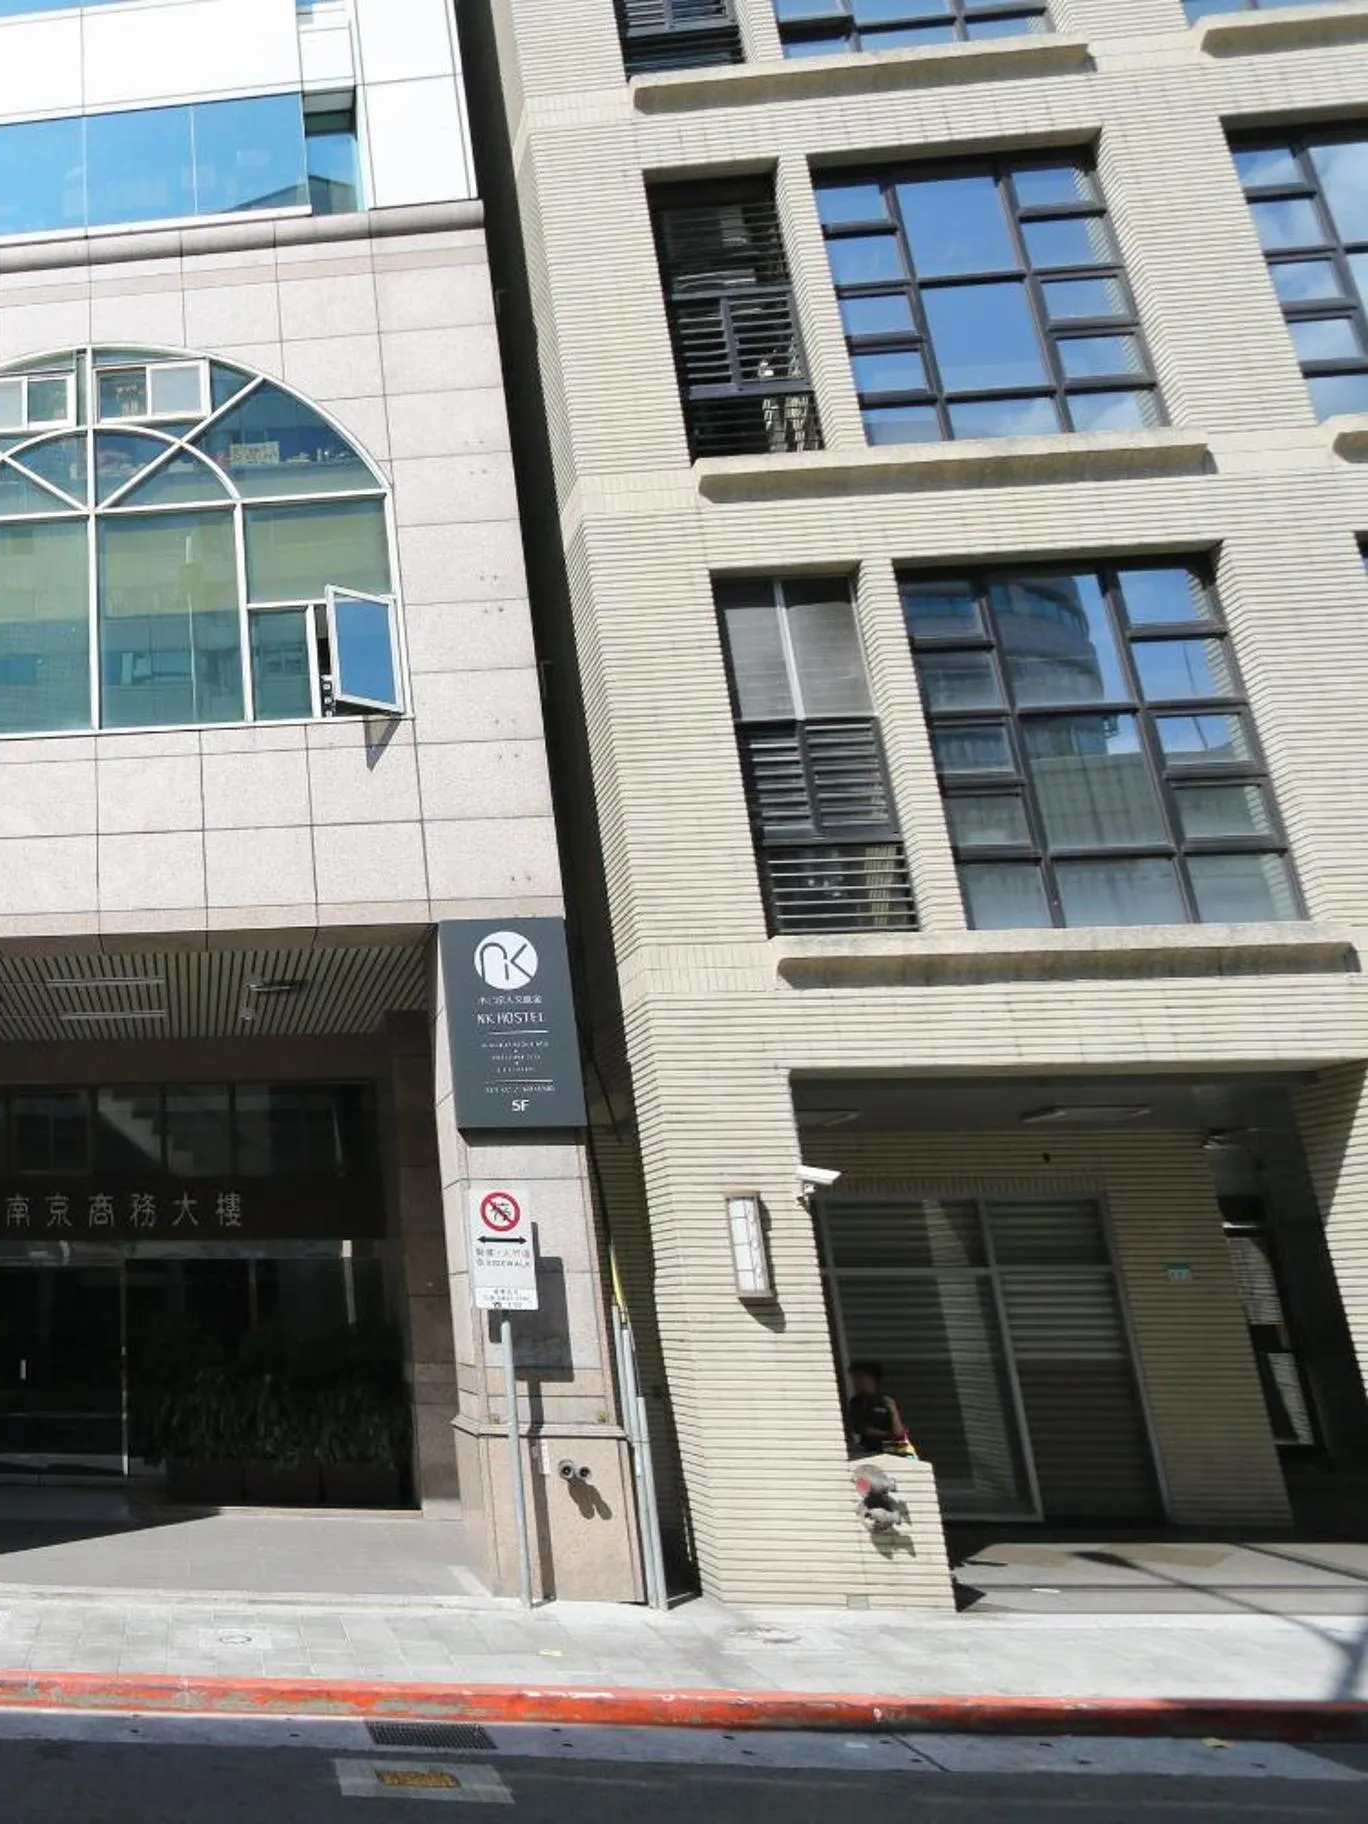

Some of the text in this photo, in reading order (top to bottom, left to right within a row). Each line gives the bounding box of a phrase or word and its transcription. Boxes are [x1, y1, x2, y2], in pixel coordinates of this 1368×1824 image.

[497, 1011, 548, 1025] HOSTEL
[511, 1099, 531, 1113] 5F
[5, 1191, 243, 1228] 南京商務大樓
